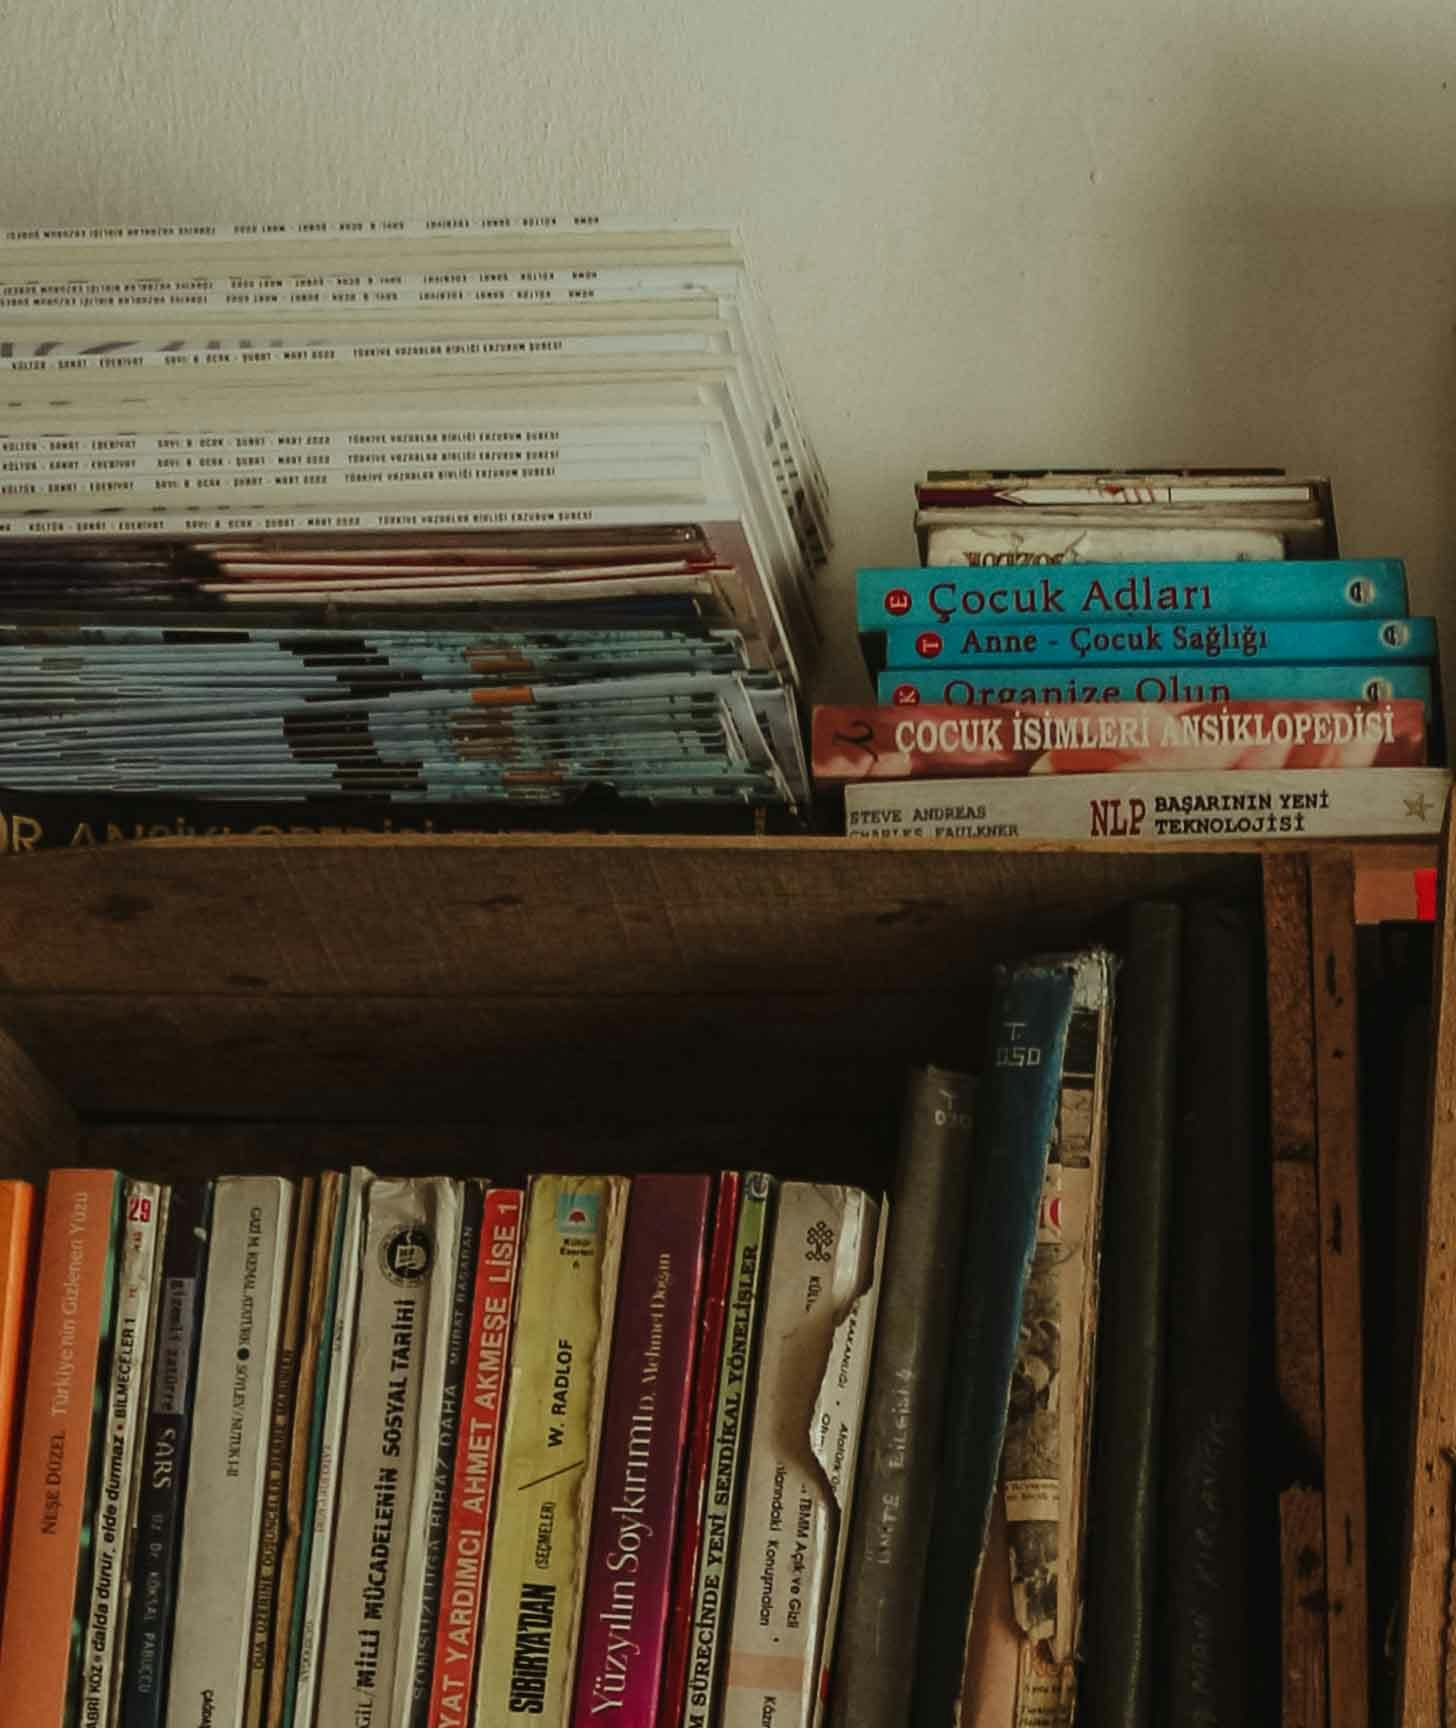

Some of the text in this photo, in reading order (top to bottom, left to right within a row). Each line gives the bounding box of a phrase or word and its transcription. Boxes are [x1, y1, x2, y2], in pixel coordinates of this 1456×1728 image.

[928, 579, 1211, 622] Çocuk Adları
[960, 626, 1267, 655] Anne Çocuk Sağlığı
[1137, 678, 1231, 705] Olun
[1012, 711, 1150, 750] İSİMLERİ
[1090, 800, 1145, 836] NLP
[1155, 790, 1329, 815] BAŞARININ YENİ
[1155, 814, 1306, 835] TEKNOLOJİSİ
[484, 1226, 516, 1282] LİSE
[725, 1245, 760, 1384] YÖNELİŞLER
[114, 1333, 134, 1419] BİLMECELER
[471, 1298, 507, 1409] AKMEŞE
[550, 1340, 572, 1415] RADLOF
[104, 1435, 126, 1508] durmaz
[454, 1418, 493, 1514] AHMET
[712, 1393, 740, 1505] SENDİKAL
[353, 1300, 415, 1688] MİLLİ MÜCADELENİN SOSYAL TARİHİ
[588, 1406, 660, 1713] Yüzyılın Soykırımı
[706, 1514, 727, 1567] YENİ
[444, 1529, 482, 1662] YARDIMCI
[509, 1584, 555, 1712] SİBİRYA'DAN
[687, 1574, 721, 1707] SÜRECİNDE
